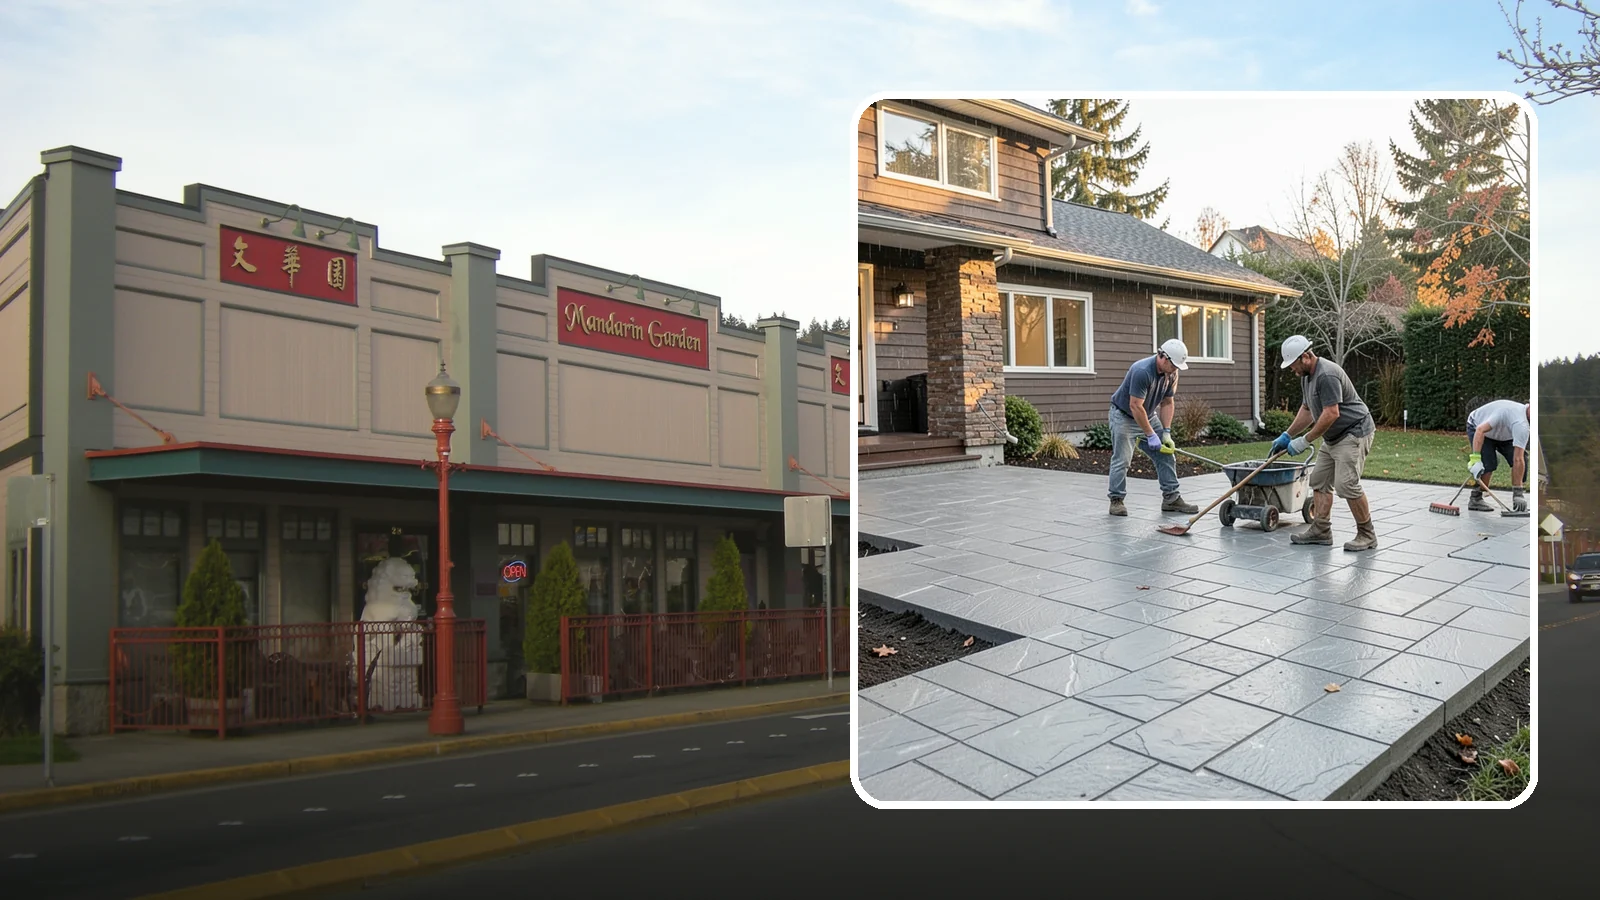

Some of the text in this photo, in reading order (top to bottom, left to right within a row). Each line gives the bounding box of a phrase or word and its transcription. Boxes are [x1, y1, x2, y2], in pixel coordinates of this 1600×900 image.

[230, 235, 346, 291] 文華園
[564, 302, 701, 352] Mandarin Garden
[503, 565, 527, 578] OPEN
